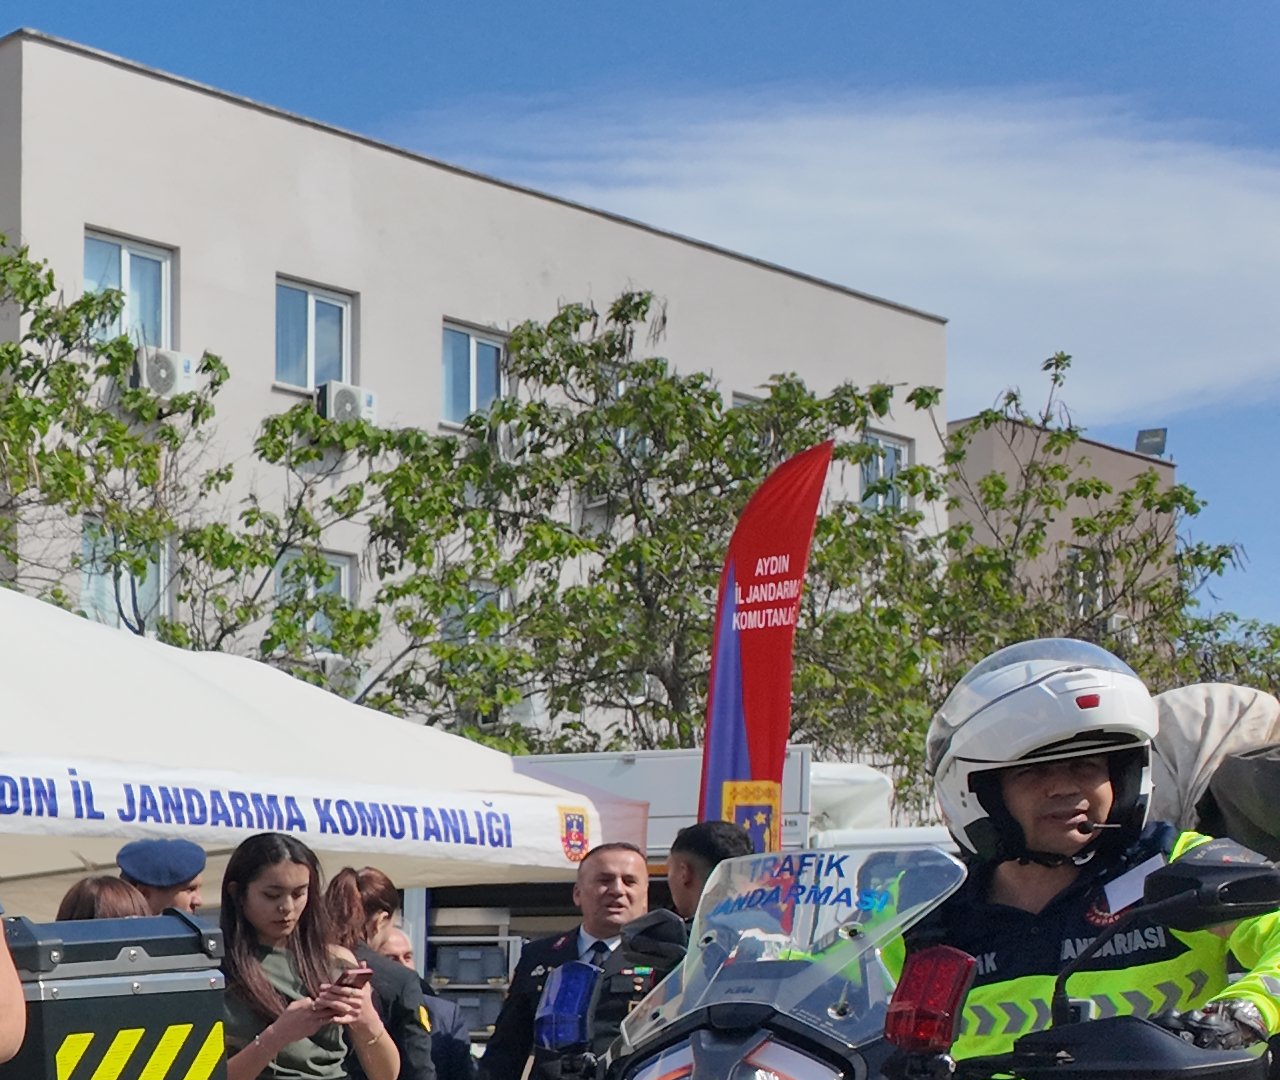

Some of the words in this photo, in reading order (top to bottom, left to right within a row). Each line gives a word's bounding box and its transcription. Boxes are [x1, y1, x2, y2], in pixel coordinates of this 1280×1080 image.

[755, 554, 789, 577] AYDIN
[734, 579, 745, 606] İL
[67, 768, 105, 821] İL
[117, 783, 307, 833] JANDARMA
[312, 797, 513, 849] KOMUTANLIĞI
